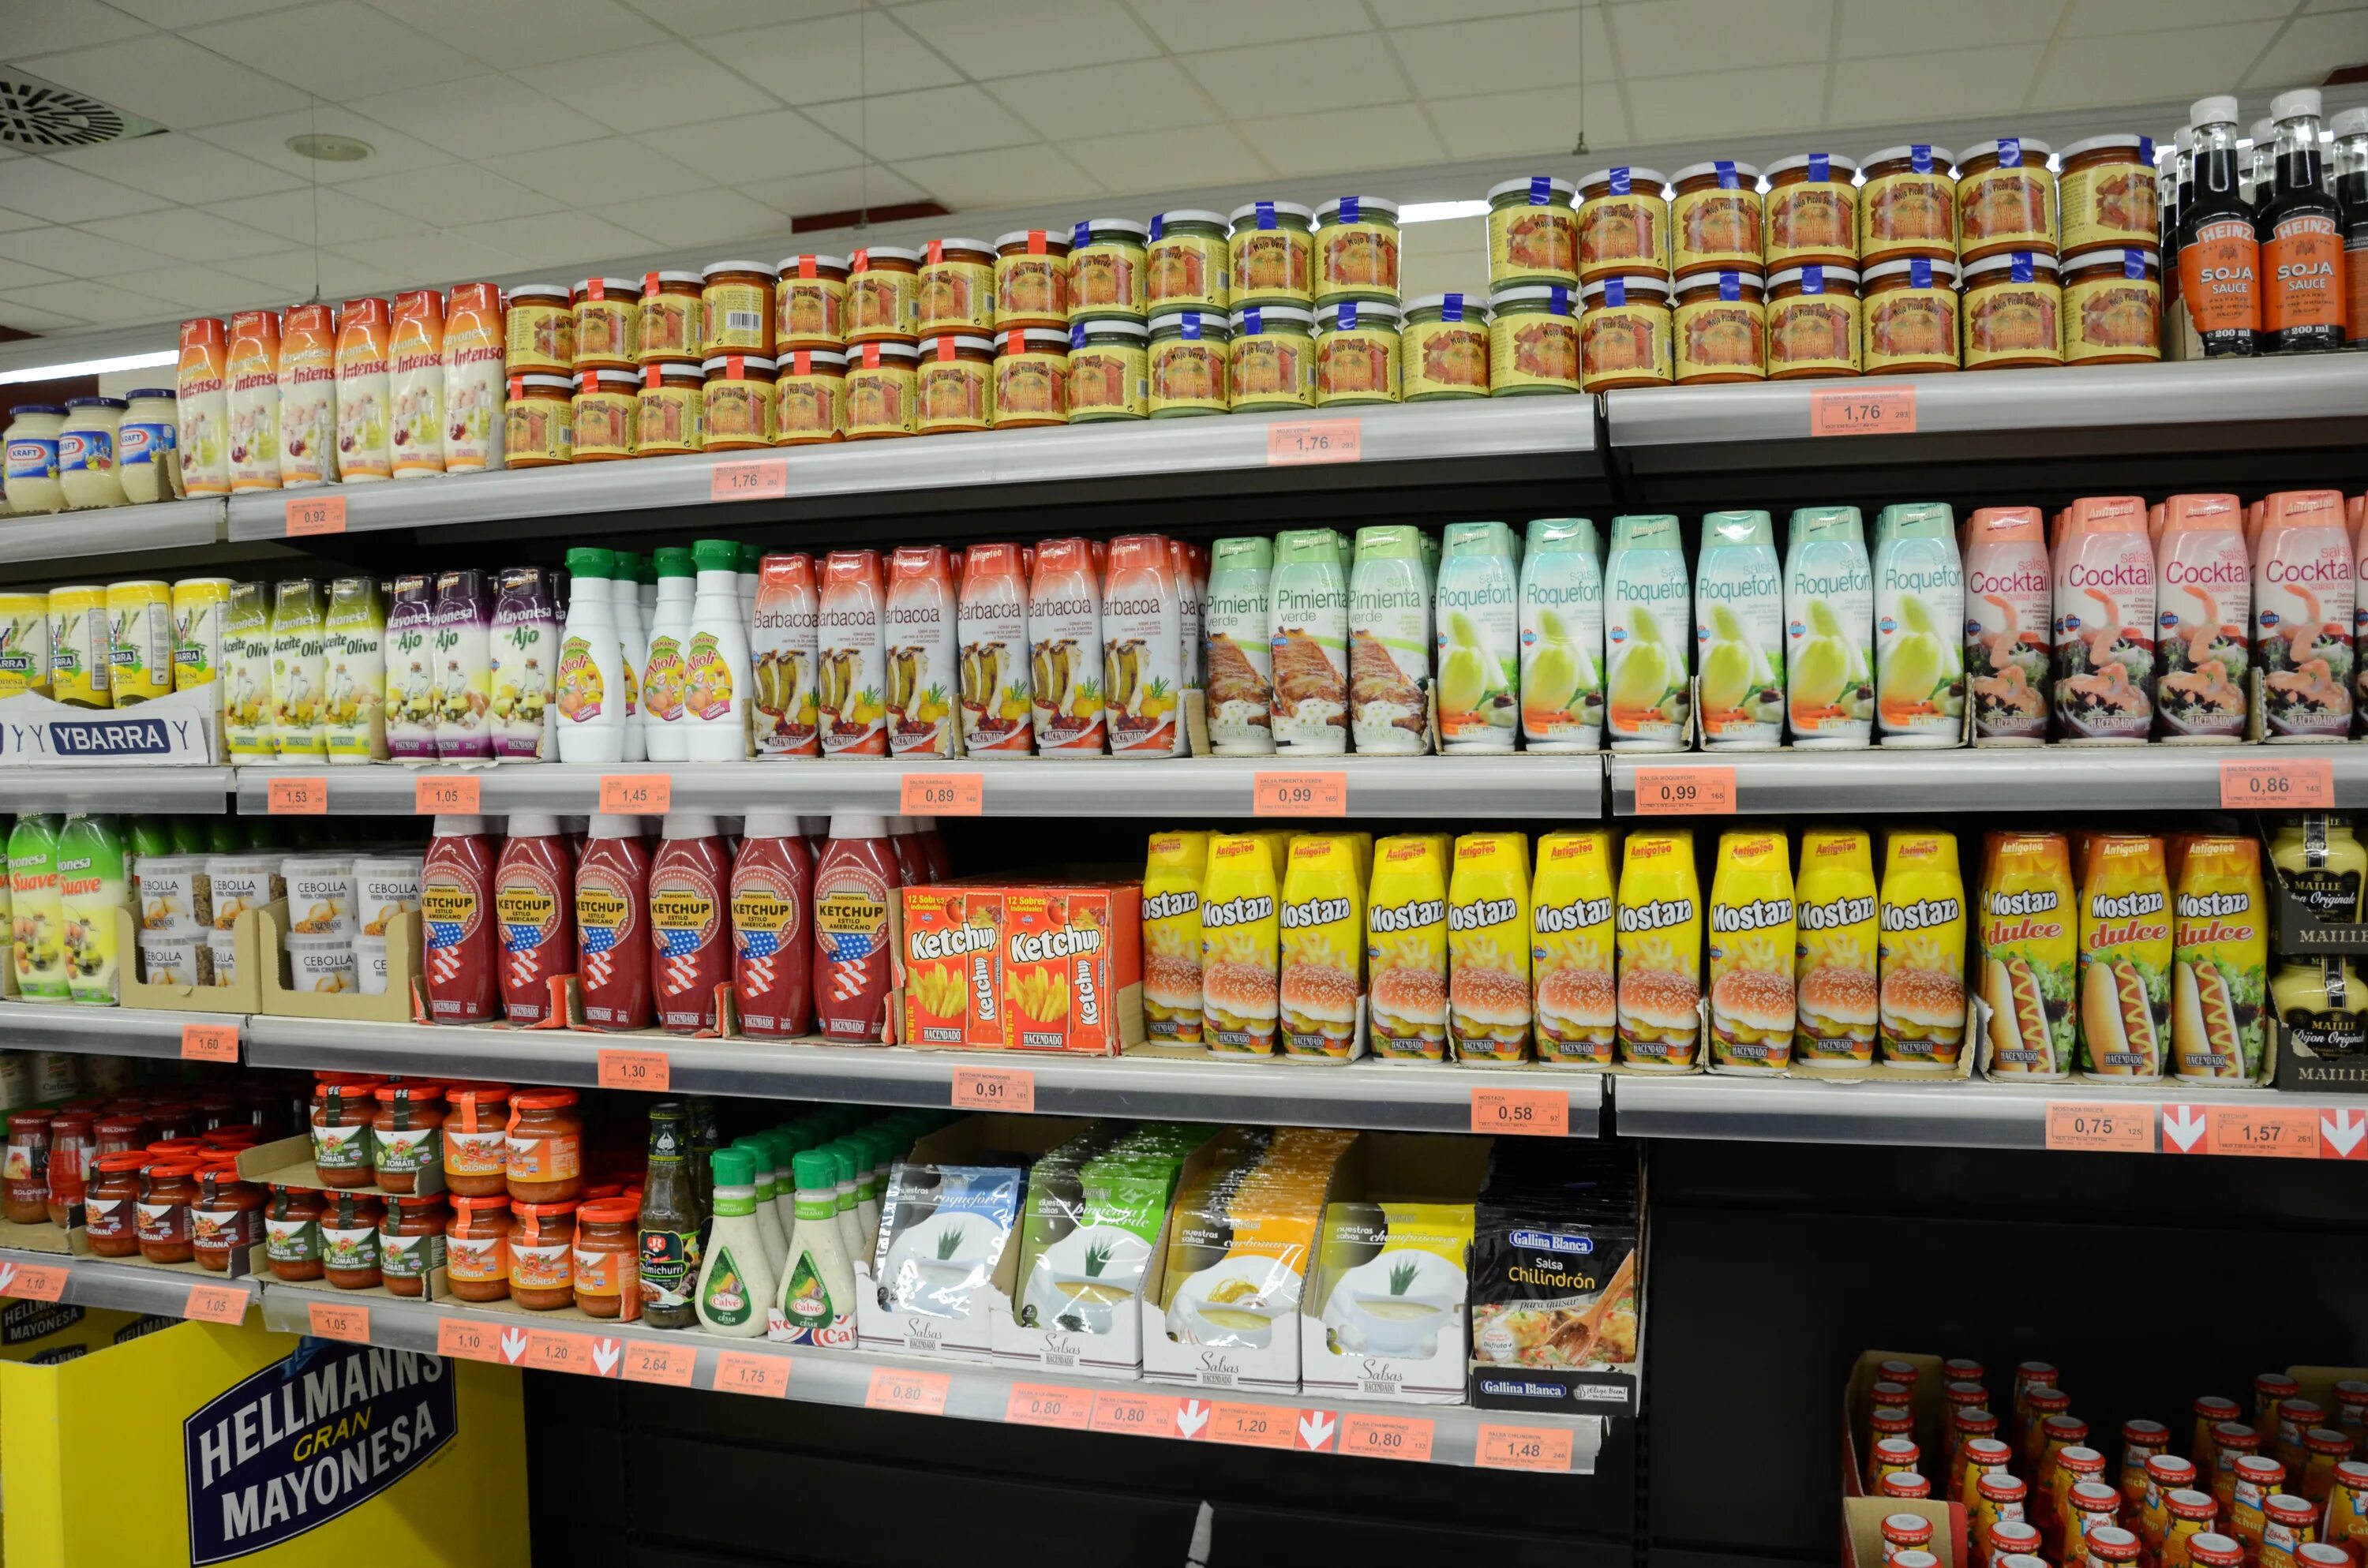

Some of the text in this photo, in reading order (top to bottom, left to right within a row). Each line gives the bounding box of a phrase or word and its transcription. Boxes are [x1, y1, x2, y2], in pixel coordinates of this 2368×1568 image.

[2202, 226, 2251, 243] HEINZ
[2280, 220, 2332, 238] HEINZ
[2201, 267, 2254, 283] SOJA
[2277, 262, 2334, 280] SOJA
[2212, 283, 2248, 294] SAUCE
[2288, 279, 2325, 290] SAUCE
[2215, 328, 2250, 338] 200 ml
[2291, 326, 2313, 335] 200
[455, 346, 504, 367] Intenso
[343, 360, 388, 380] Intenso
[180, 378, 222, 400] Intenso
[1845, 405, 1880, 421] 1,76
[1296, 436, 1328, 453] 1,76
[13, 449, 38, 458] KRAFT
[732, 474, 758, 488] 1,76
[305, 511, 325, 524] 0,92
[1742, 562, 1774, 575] salsa
[2018, 558, 2048, 571] salsa
[2266, 559, 2355, 582] Cocktail
[1478, 571, 1509, 585] salsa
[1970, 571, 2050, 593] Cocktail
[2069, 563, 2154, 587] Cocktail
[1699, 576, 1778, 603] Roquefort
[1349, 589, 1422, 608] Pimienta
[1439, 586, 1512, 611] Roquefort
[958, 601, 1021, 621] Barbacoa
[1029, 597, 1092, 618] Barbacoa
[497, 607, 552, 625] Mayonesa
[754, 610, 819, 628] Barbacoa
[1280, 610, 1317, 622] verde
[274, 636, 301, 653] Aceite
[398, 631, 422, 654] Ajo
[436, 628, 459, 653] Ajo
[512, 625, 540, 649] Ajo
[347, 641, 377, 654] Oliva
[560, 655, 588, 678] Alioli
[687, 650, 717, 676] Alioli
[29, 720, 189, 753] Y YBARRA Y
[1661, 786, 1696, 802] 0,99
[2250, 778, 2289, 795] 0,86
[287, 791, 307, 804] 1,53
[435, 791, 458, 803] 1,05
[622, 790, 647, 803] 1,45
[925, 790, 954, 803] 0,89
[1279, 788, 1311, 803] 0,99
[13, 873, 58, 893] Suave
[61, 877, 101, 896] Suave
[298, 881, 347, 893] CEBOLLA
[368, 883, 418, 894] CEBOLLA
[2295, 881, 2341, 891] MAILLE
[422, 897, 473, 908] KETCHUP
[498, 900, 552, 910] KETCHUP
[577, 900, 624, 912] KETCHUP
[1020, 896, 1046, 905] Sobres
[1990, 890, 2058, 915] Mostaza
[2093, 892, 2164, 919] Mostaza
[2176, 892, 2250, 918] Mostaza
[2310, 891, 2356, 908] Originale
[652, 903, 710, 915] KETCHUP
[733, 904, 789, 915] KETCHUP
[819, 905, 883, 917] KETCHUP
[1370, 899, 1445, 933] Mostaza
[1534, 896, 1613, 933] Mostaza
[1713, 899, 1793, 932] Mostaza
[1988, 919, 2062, 947] dulce
[2089, 921, 2168, 947] dulce
[2174, 921, 2254, 947] dulce
[2299, 930, 2368, 942] MAILLE
[911, 922, 998, 960] Ketchup
[1010, 923, 1101, 963] Ketchup
[303, 955, 354, 967] CEBOLLA
[972, 956, 996, 1021] Ketchup
[1074, 960, 1099, 1025] Ketchup
[924, 1029, 961, 1041] HACENDADO
[1023, 1034, 1062, 1046] HACENDADO
[200, 1038, 218, 1050] 1,60
[621, 1065, 646, 1078] 1,30
[2299, 1068, 2368, 1081] MAILLE
[976, 1083, 1003, 1097] 0,91
[1498, 1106, 1532, 1121] 0,58
[2074, 1118, 2112, 1135] 0,75
[2242, 1126, 2281, 1143] 1,57
[320, 1154, 345, 1163] TOMATE
[897, 1186, 929, 1196] nuestras
[1182, 1229, 1219, 1240] nuestras
[1336, 1233, 1360, 1241] salsas
[1337, 1226, 1373, 1236] nuestras
[1182, 1236, 1205, 1244] salsas
[1513, 1232, 1588, 1252] Gallina Blanca
[1535, 1258, 1564, 1271] Salsa
[26, 1278, 45, 1289] 1,10
[1508, 1266, 1596, 1289] Chilindrón
[205, 1300, 226, 1312] 1,05
[714, 1297, 739, 1308] Calvé
[794, 1300, 821, 1313] Calvé
[1519, 1297, 1579, 1312] para guisar
[325, 1319, 347, 1331] 1,05
[718, 1314, 736, 1323] CÉSAR
[903, 1318, 942, 1340] Salsas
[458, 1334, 480, 1349] 1,10
[1040, 1333, 1081, 1355] Salsas
[545, 1346, 568, 1359] 1,20
[642, 1357, 667, 1372] 2,64
[1196, 1351, 1240, 1375] Salsas
[1358, 1358, 1403, 1383] Salsas
[740, 1368, 765, 1383] 1,75
[893, 1385, 921, 1401] 0,80
[1484, 1381, 1563, 1398] Gallina Blanca
[1031, 1401, 1061, 1415] 0,80
[1114, 1407, 1145, 1423] 0,80
[1236, 1418, 1267, 1433] 1,20
[293, 1406, 371, 1461] GRAN
[1369, 1432, 1402, 1447] 0,80
[1508, 1443, 1540, 1458] 1,48
[222, 1400, 437, 1541] MAYONESA
